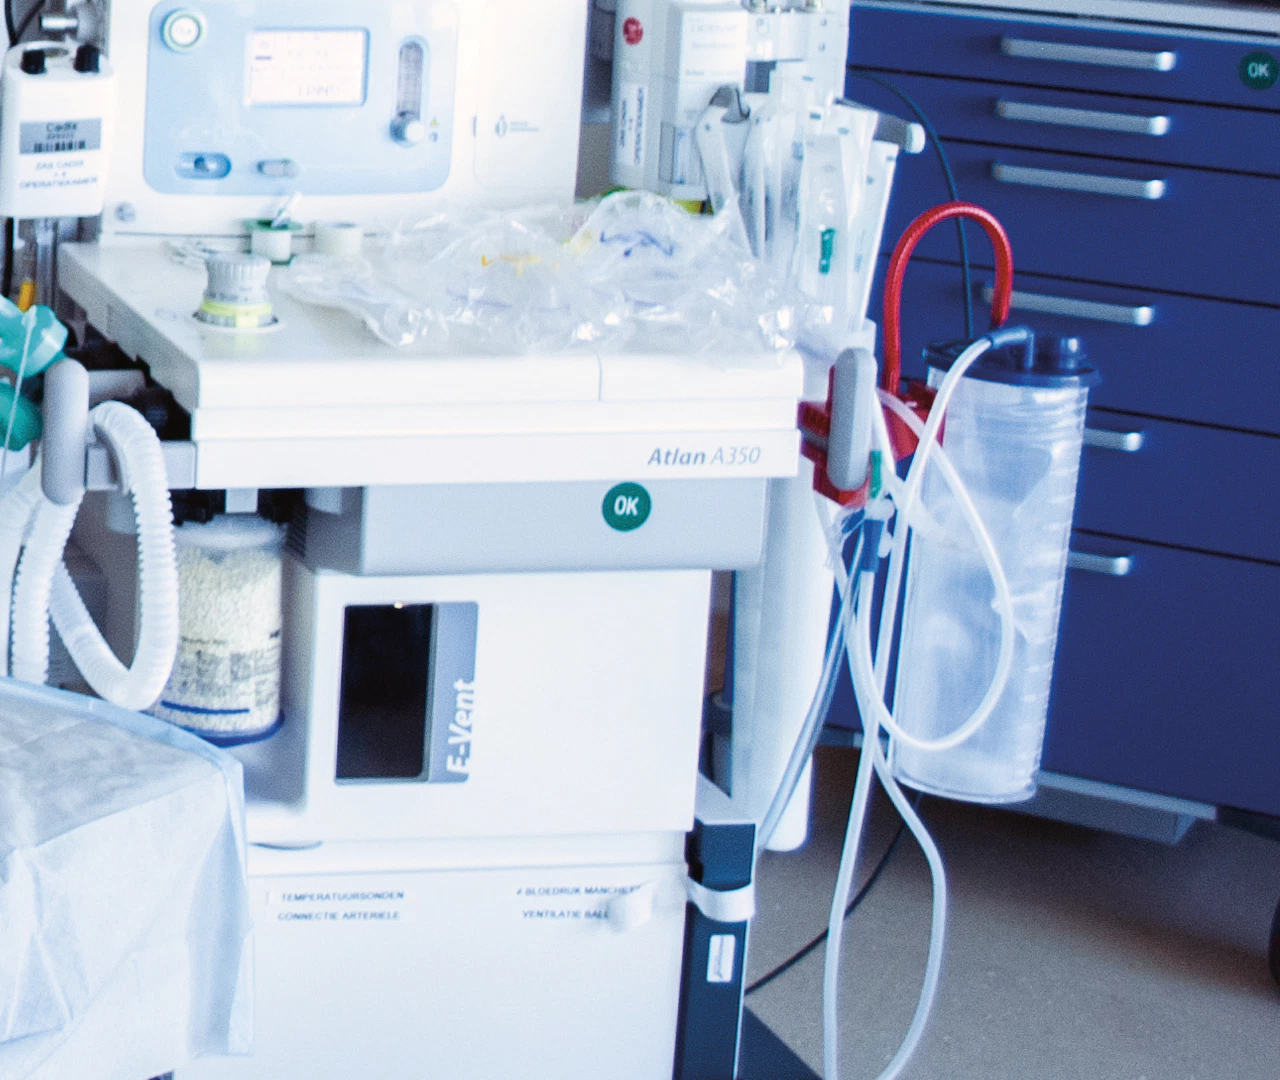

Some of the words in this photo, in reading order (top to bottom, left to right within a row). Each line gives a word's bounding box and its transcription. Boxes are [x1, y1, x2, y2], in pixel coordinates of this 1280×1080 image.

[1248, 62, 1269, 78] OK
[647, 447, 707, 466] Atlan
[709, 446, 762, 465] A350
[613, 494, 639, 517] OK
[446, 678, 475, 774] E-Vent
[277, 911, 338, 921] CONNECTIE
